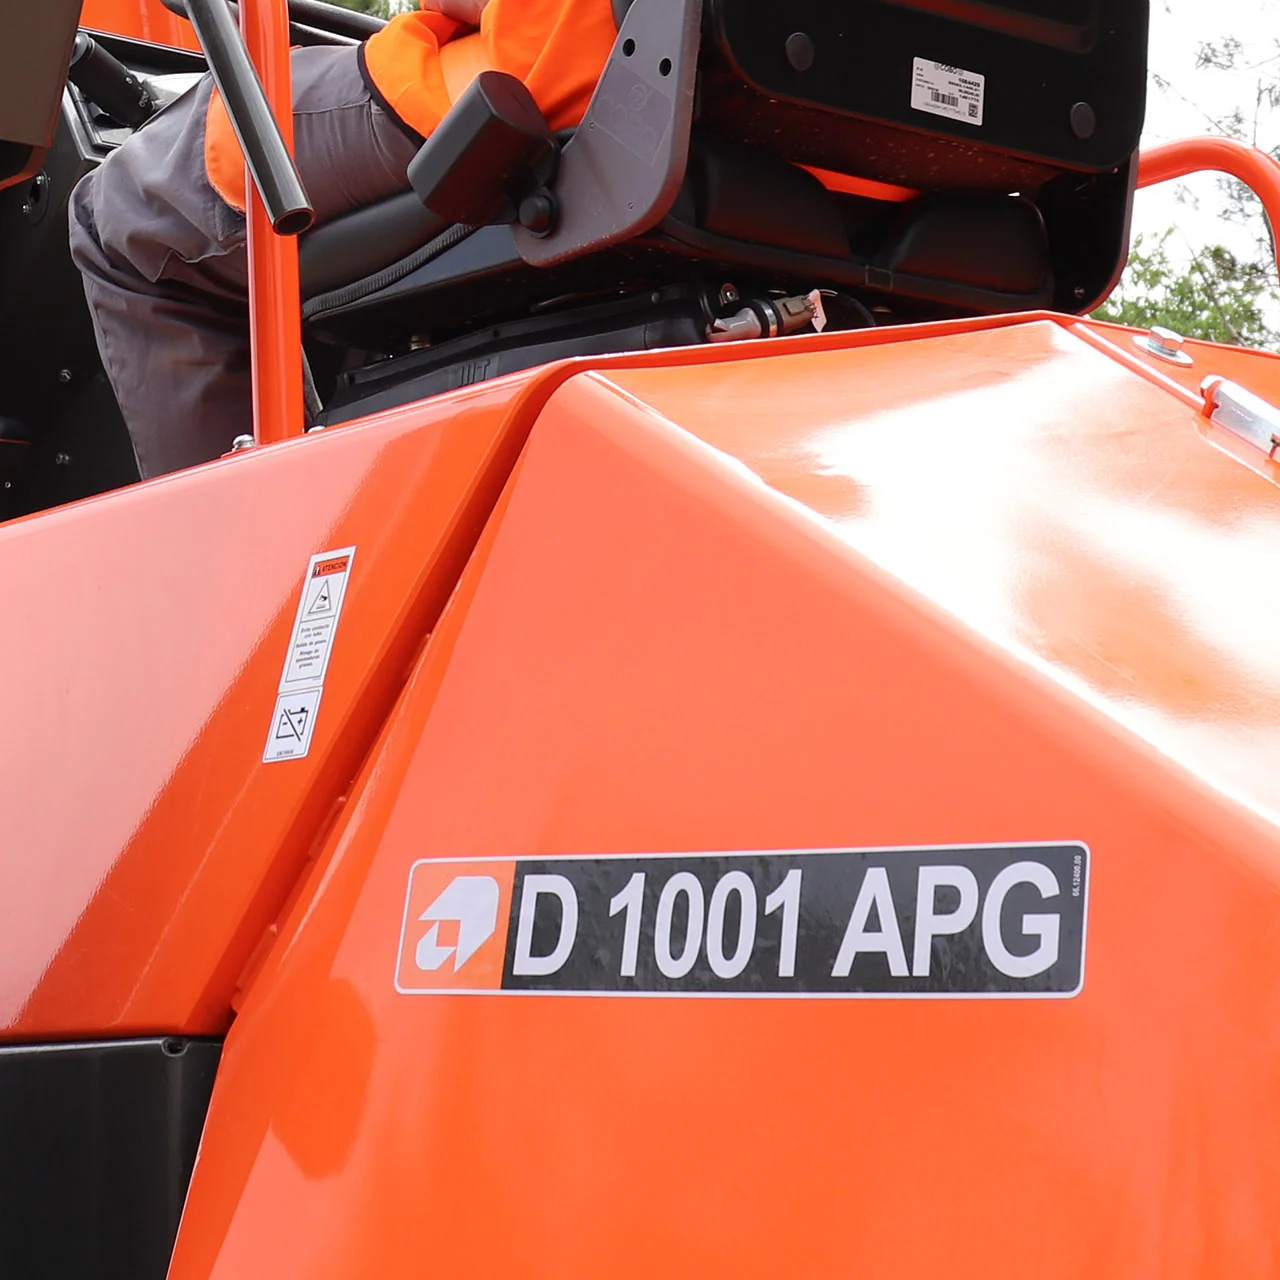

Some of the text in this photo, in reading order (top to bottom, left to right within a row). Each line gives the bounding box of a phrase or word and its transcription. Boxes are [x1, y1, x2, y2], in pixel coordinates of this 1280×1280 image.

[513, 861, 1061, 979] D 1001 APG
